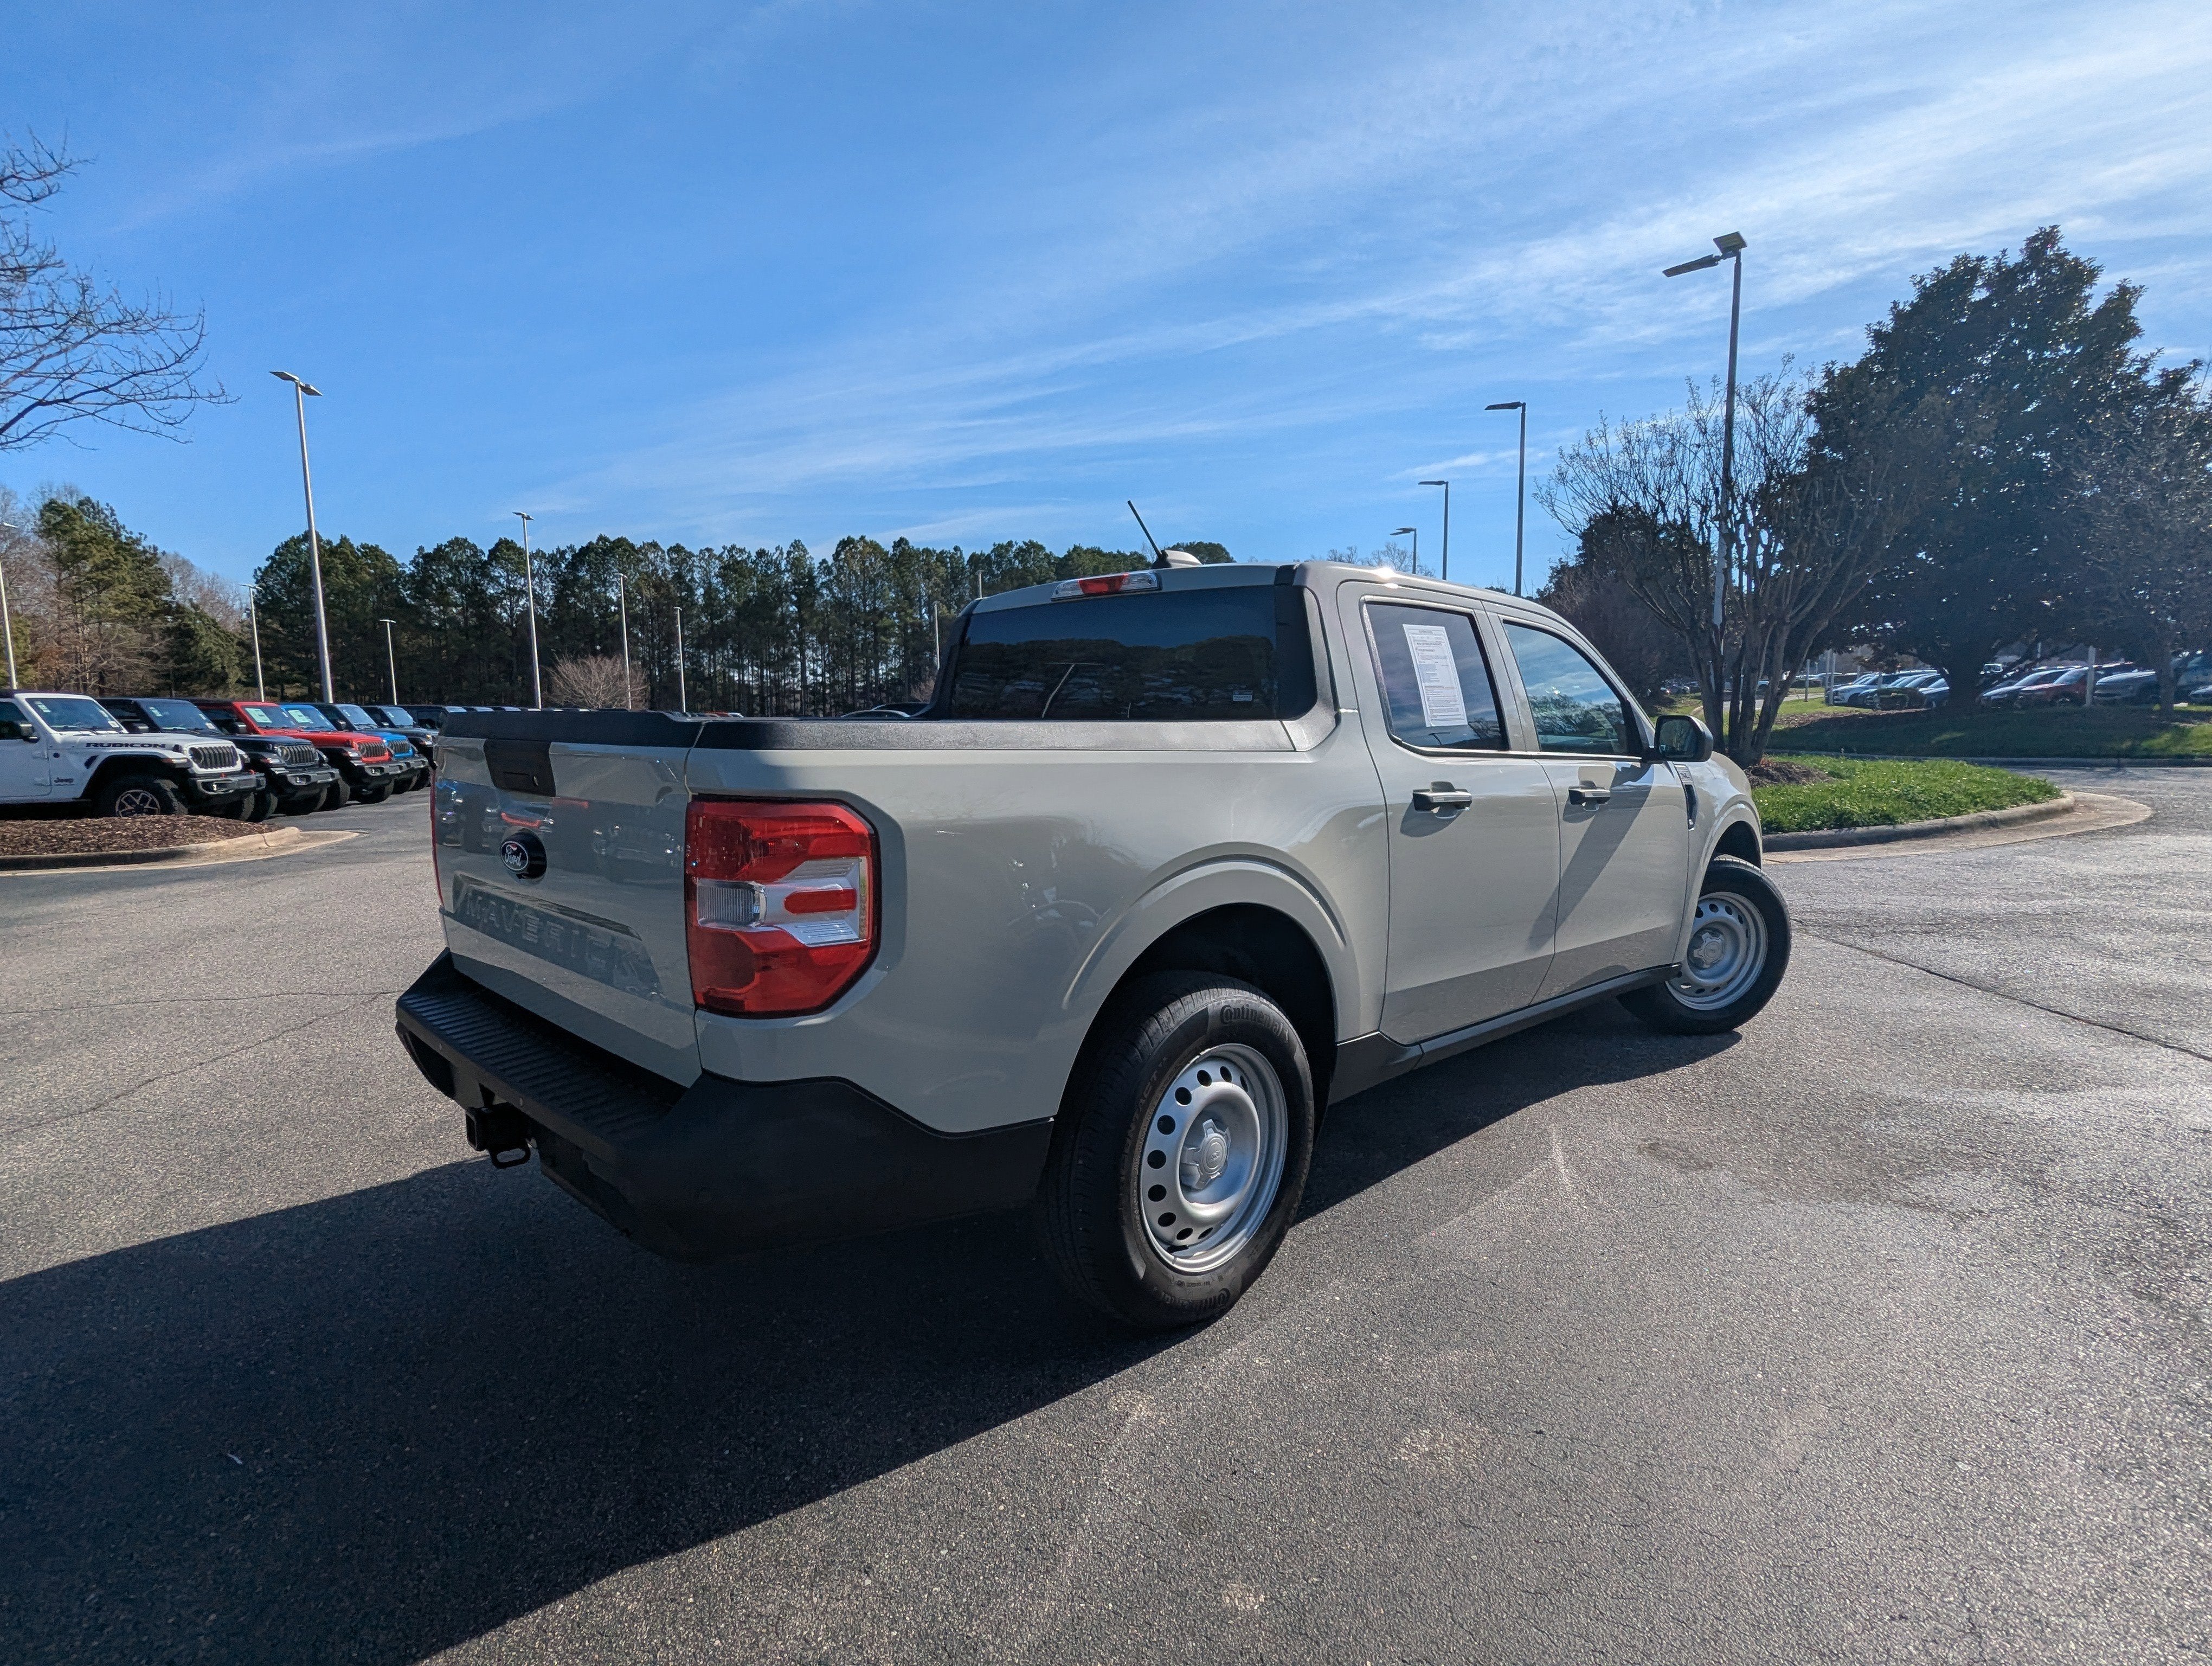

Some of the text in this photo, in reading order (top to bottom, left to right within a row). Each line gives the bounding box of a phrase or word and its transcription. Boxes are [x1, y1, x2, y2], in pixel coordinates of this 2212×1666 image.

[504, 844, 522, 867] Ford
[464, 890, 642, 994] MAVERICK
[1220, 1004, 1284, 1037] Continental
